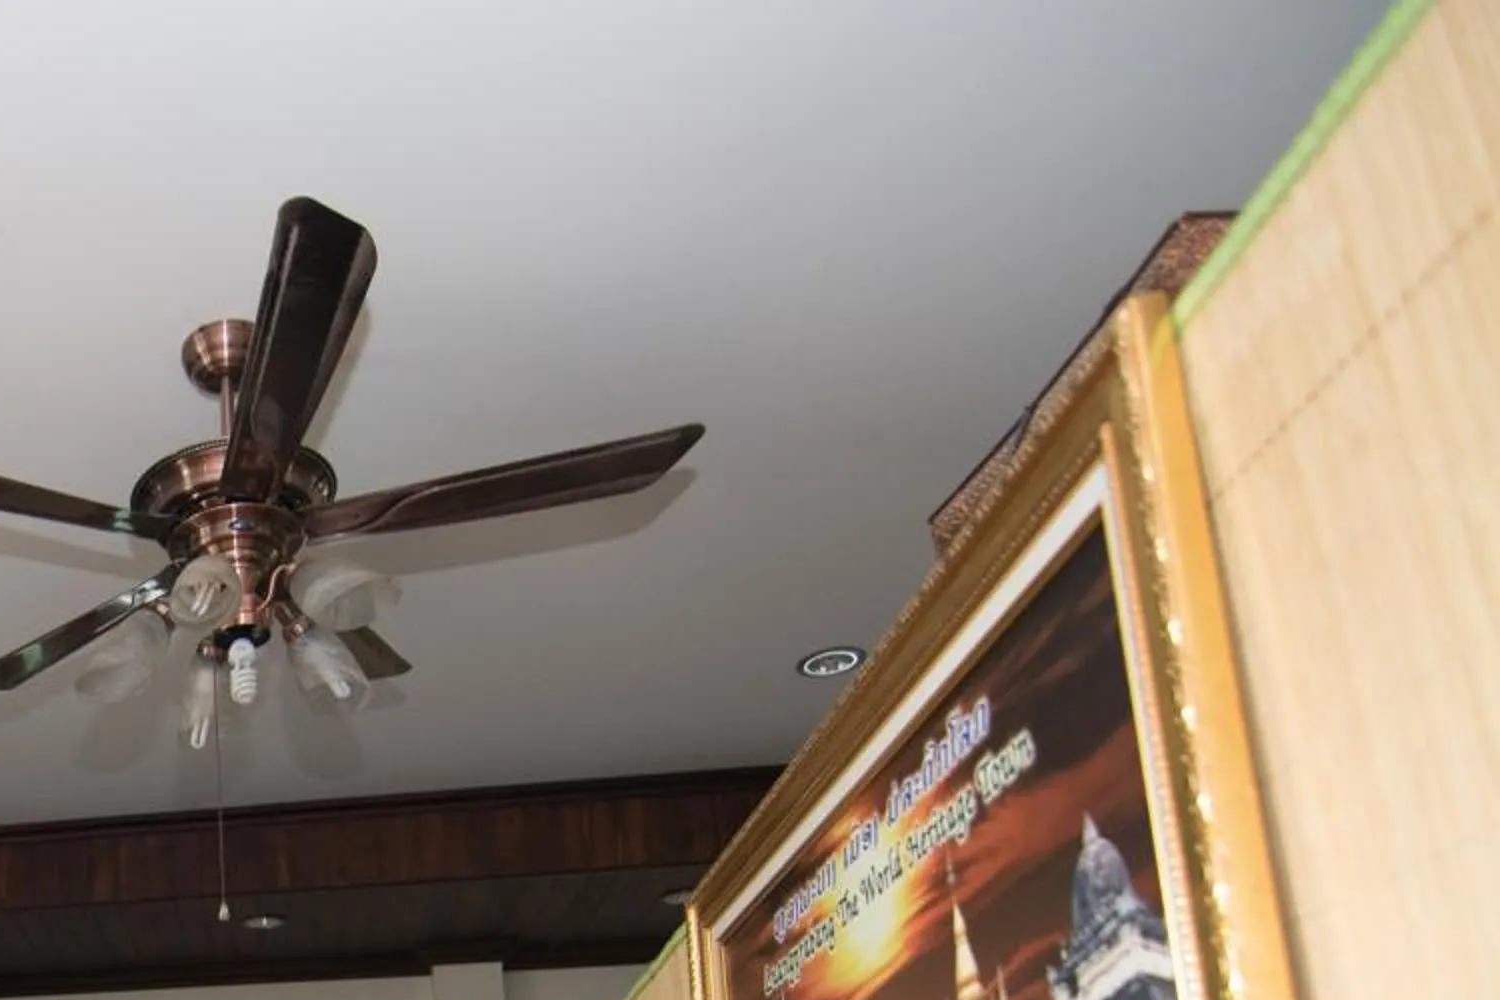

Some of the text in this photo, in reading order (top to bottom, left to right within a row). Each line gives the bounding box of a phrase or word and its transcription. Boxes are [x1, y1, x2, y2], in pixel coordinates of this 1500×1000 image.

[836, 888, 859, 927] The
[860, 841, 903, 904] World
[905, 784, 973, 869] Heritage
[975, 729, 1035, 803] Town
